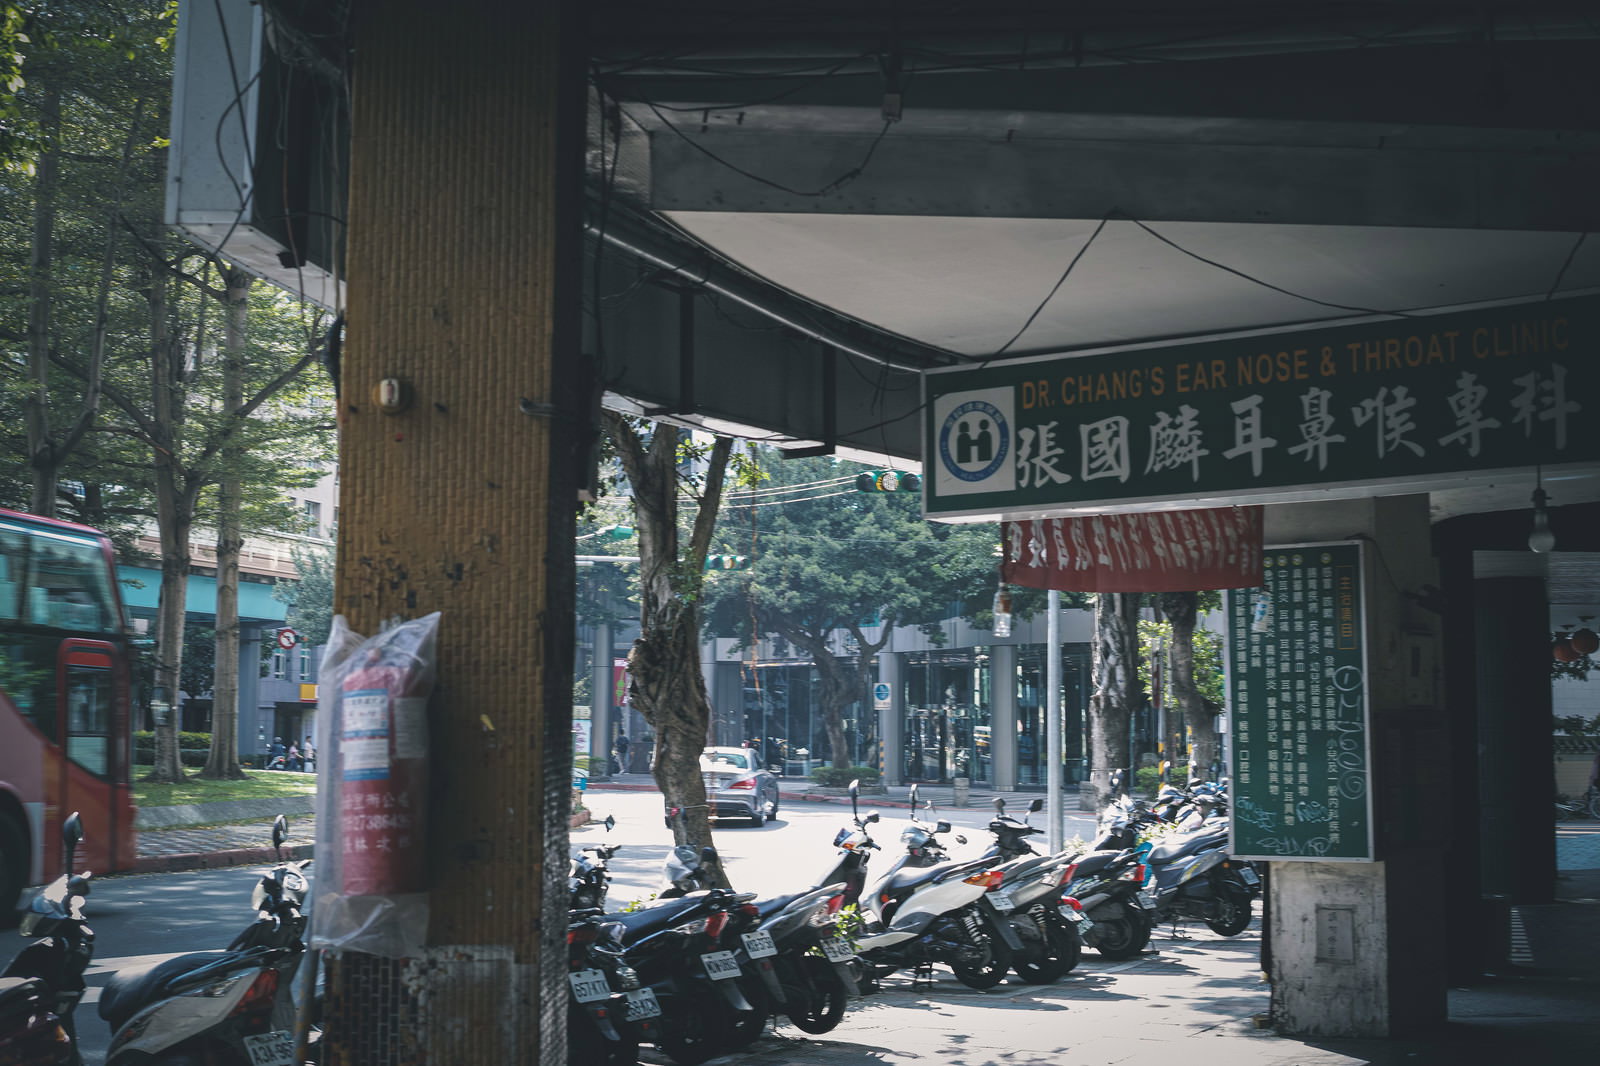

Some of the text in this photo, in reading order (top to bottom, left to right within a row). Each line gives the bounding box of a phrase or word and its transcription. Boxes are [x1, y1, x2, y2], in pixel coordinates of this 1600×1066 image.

[1021, 318, 1569, 409] DR. CHANG'S EAR NOSE & THROAT CLINIC
[1017, 363, 1582, 488] 張國麟耳鼻喉專科
